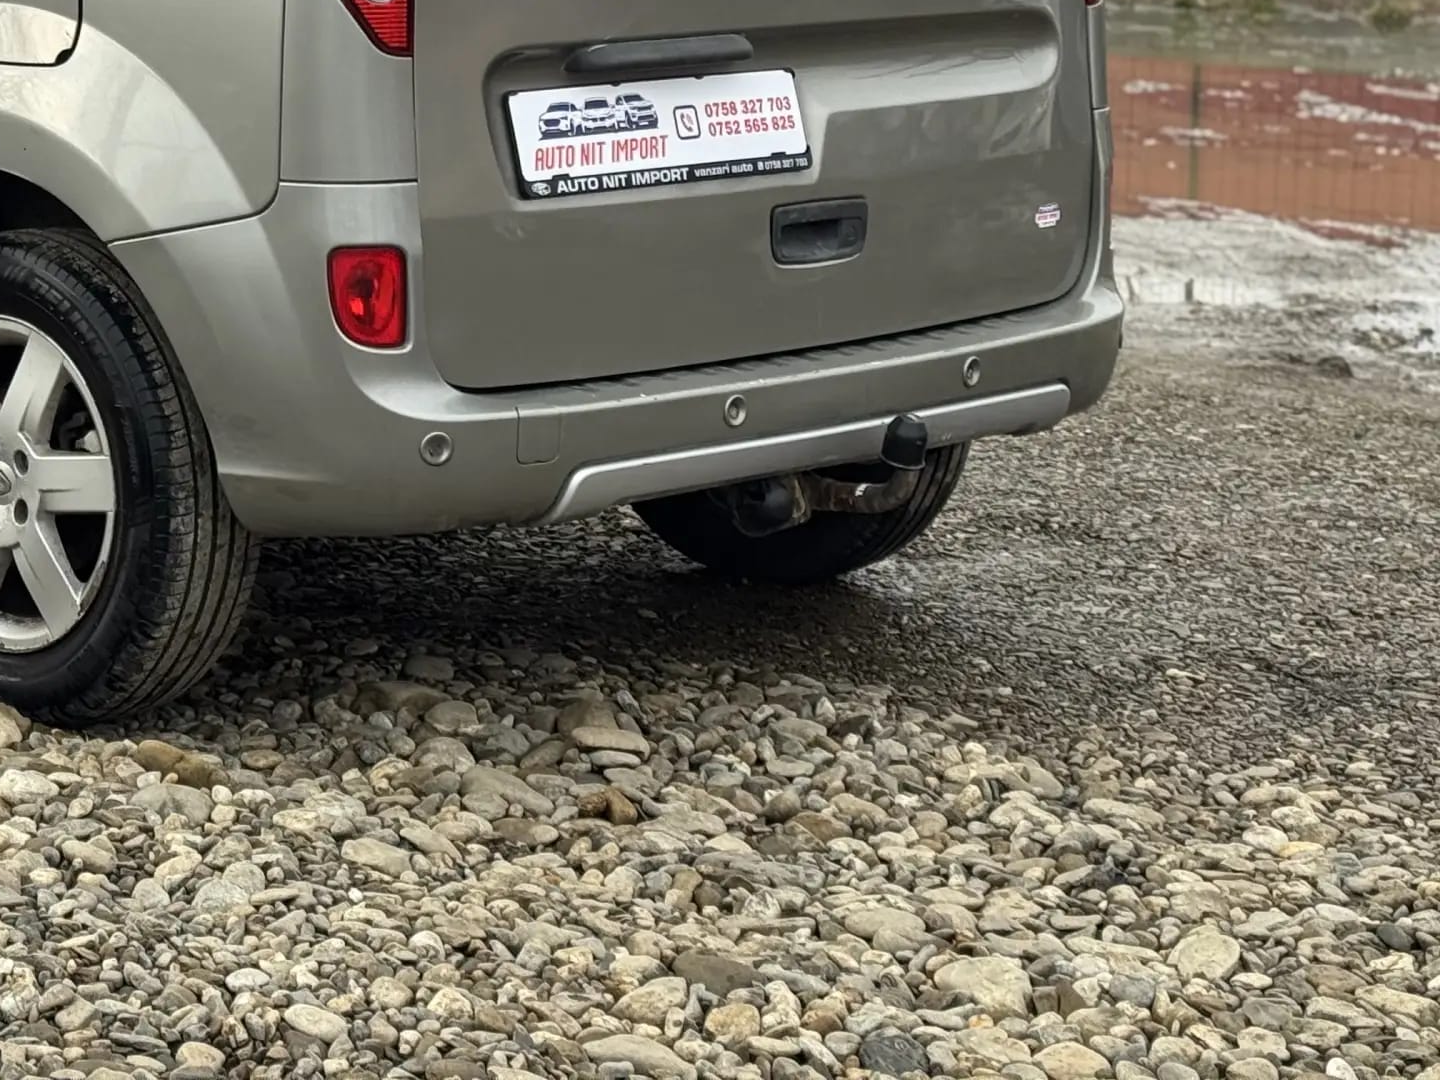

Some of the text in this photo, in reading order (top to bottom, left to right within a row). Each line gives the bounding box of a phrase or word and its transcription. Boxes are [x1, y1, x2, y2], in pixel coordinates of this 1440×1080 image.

[704, 96, 792, 118] 0758 327 703
[708, 115, 796, 137] 0752 565 825
[534, 134, 669, 172] AUTO NIT IMPORT
[556, 177, 600, 194] AUTO
[603, 173, 628, 190] NIT
[631, 167, 689, 186] IMPORT
[731, 163, 754, 174] auto
